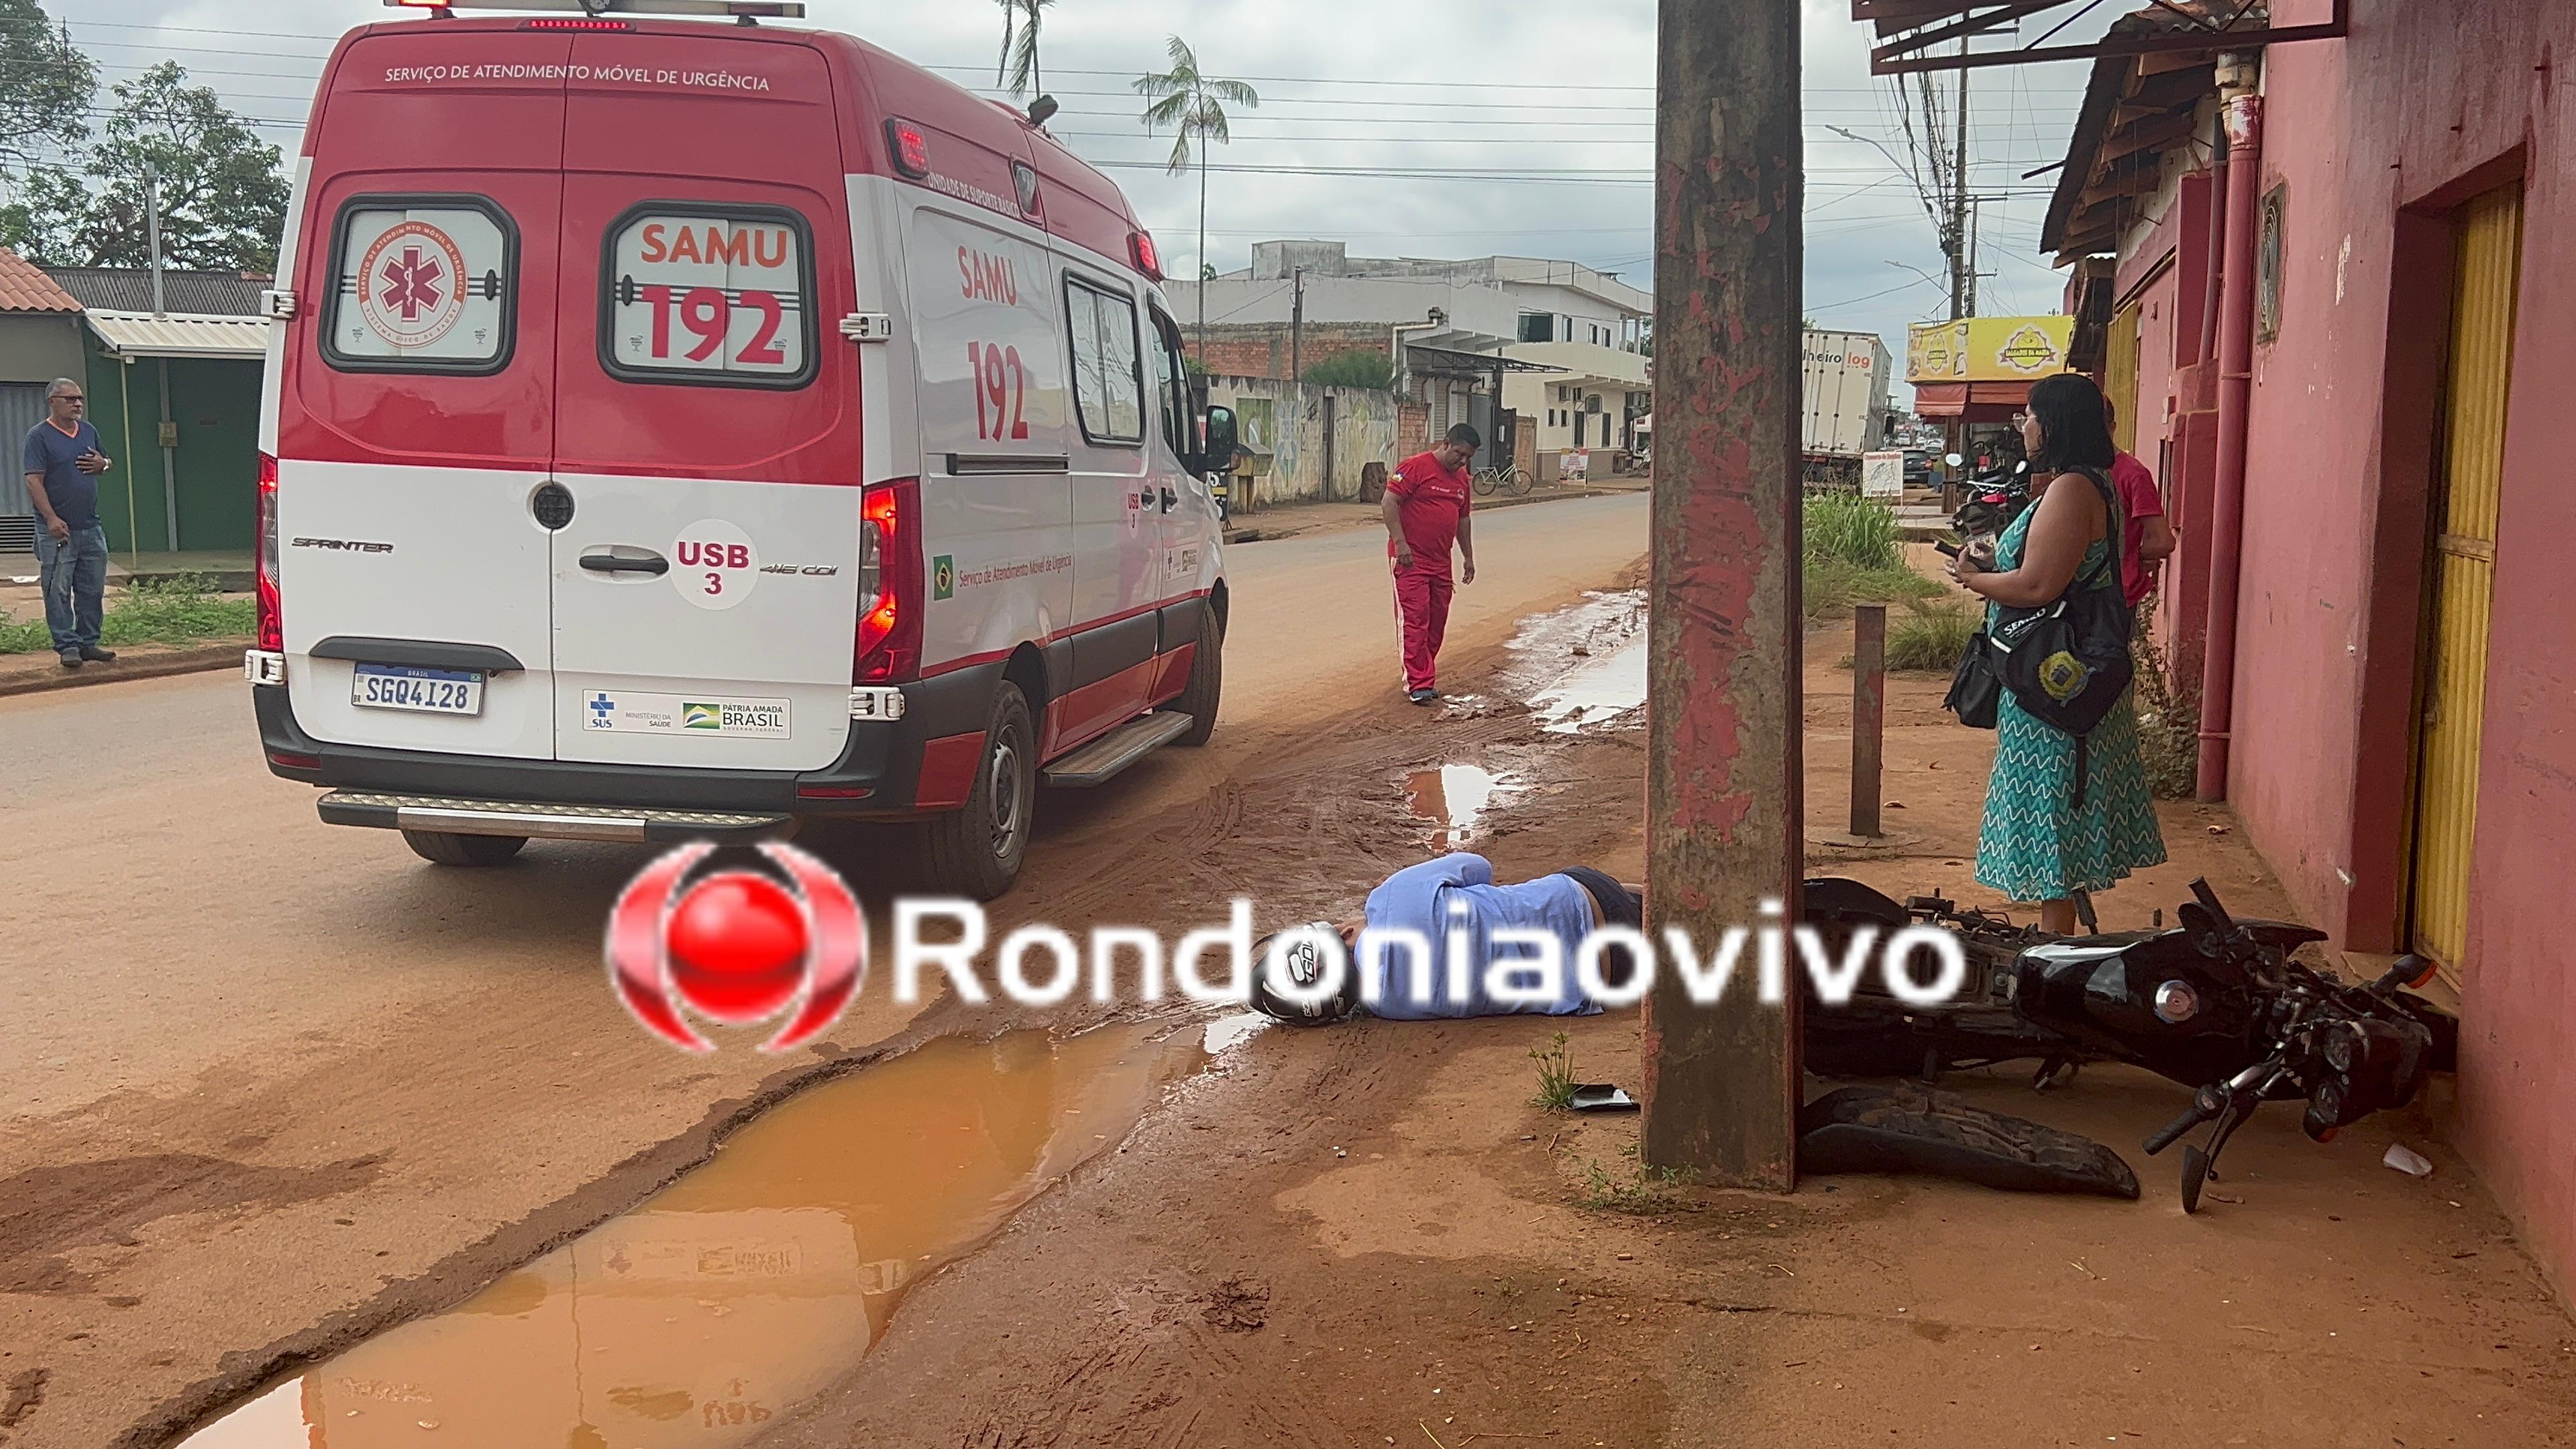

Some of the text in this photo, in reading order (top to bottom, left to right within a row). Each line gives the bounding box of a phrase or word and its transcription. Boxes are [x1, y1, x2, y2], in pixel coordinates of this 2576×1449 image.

[385, 64, 769, 91] SERVIÇO DE ATENDIMENTO MÓVEL DE URGÊNCIA
[927, 171, 961, 197] UNIDADE
[959, 181, 970, 200] DE
[969, 185, 999, 211] SUPORTE
[641, 223, 787, 268] SAMU
[361, 225, 465, 295] SERVIÇO DE ATENDIMNTO MÓVEL DE URGÊNCIA
[957, 245, 1017, 307] SAMU
[366, 308, 392, 337] SISTEMA
[423, 332, 433, 340] DE
[437, 309, 457, 333] SAÚDE
[642, 285, 784, 364] 192
[1847, 352, 1870, 368] log
[967, 341, 1029, 442] 192
[291, 537, 394, 553] SPRINTER
[678, 541, 750, 569] USB
[801, 565, 839, 576] CDI
[959, 570, 983, 588] Serviço
[983, 565, 991, 583] de
[992, 561, 1028, 582] Atendimento
[1045, 555, 1052, 572] de
[704, 573, 722, 594] 3
[407, 669, 429, 678] BRASIL
[354, 694, 361, 703] BR
[366, 677, 468, 709] SGQ4I28
[625, 711, 661, 720] MINISTÉRIO
[722, 703, 784, 713] PÁTRIA AMADA
[722, 712, 784, 727] BRASIL
[592, 718, 612, 728] SUS
[649, 719, 672, 728] SAÚDE
